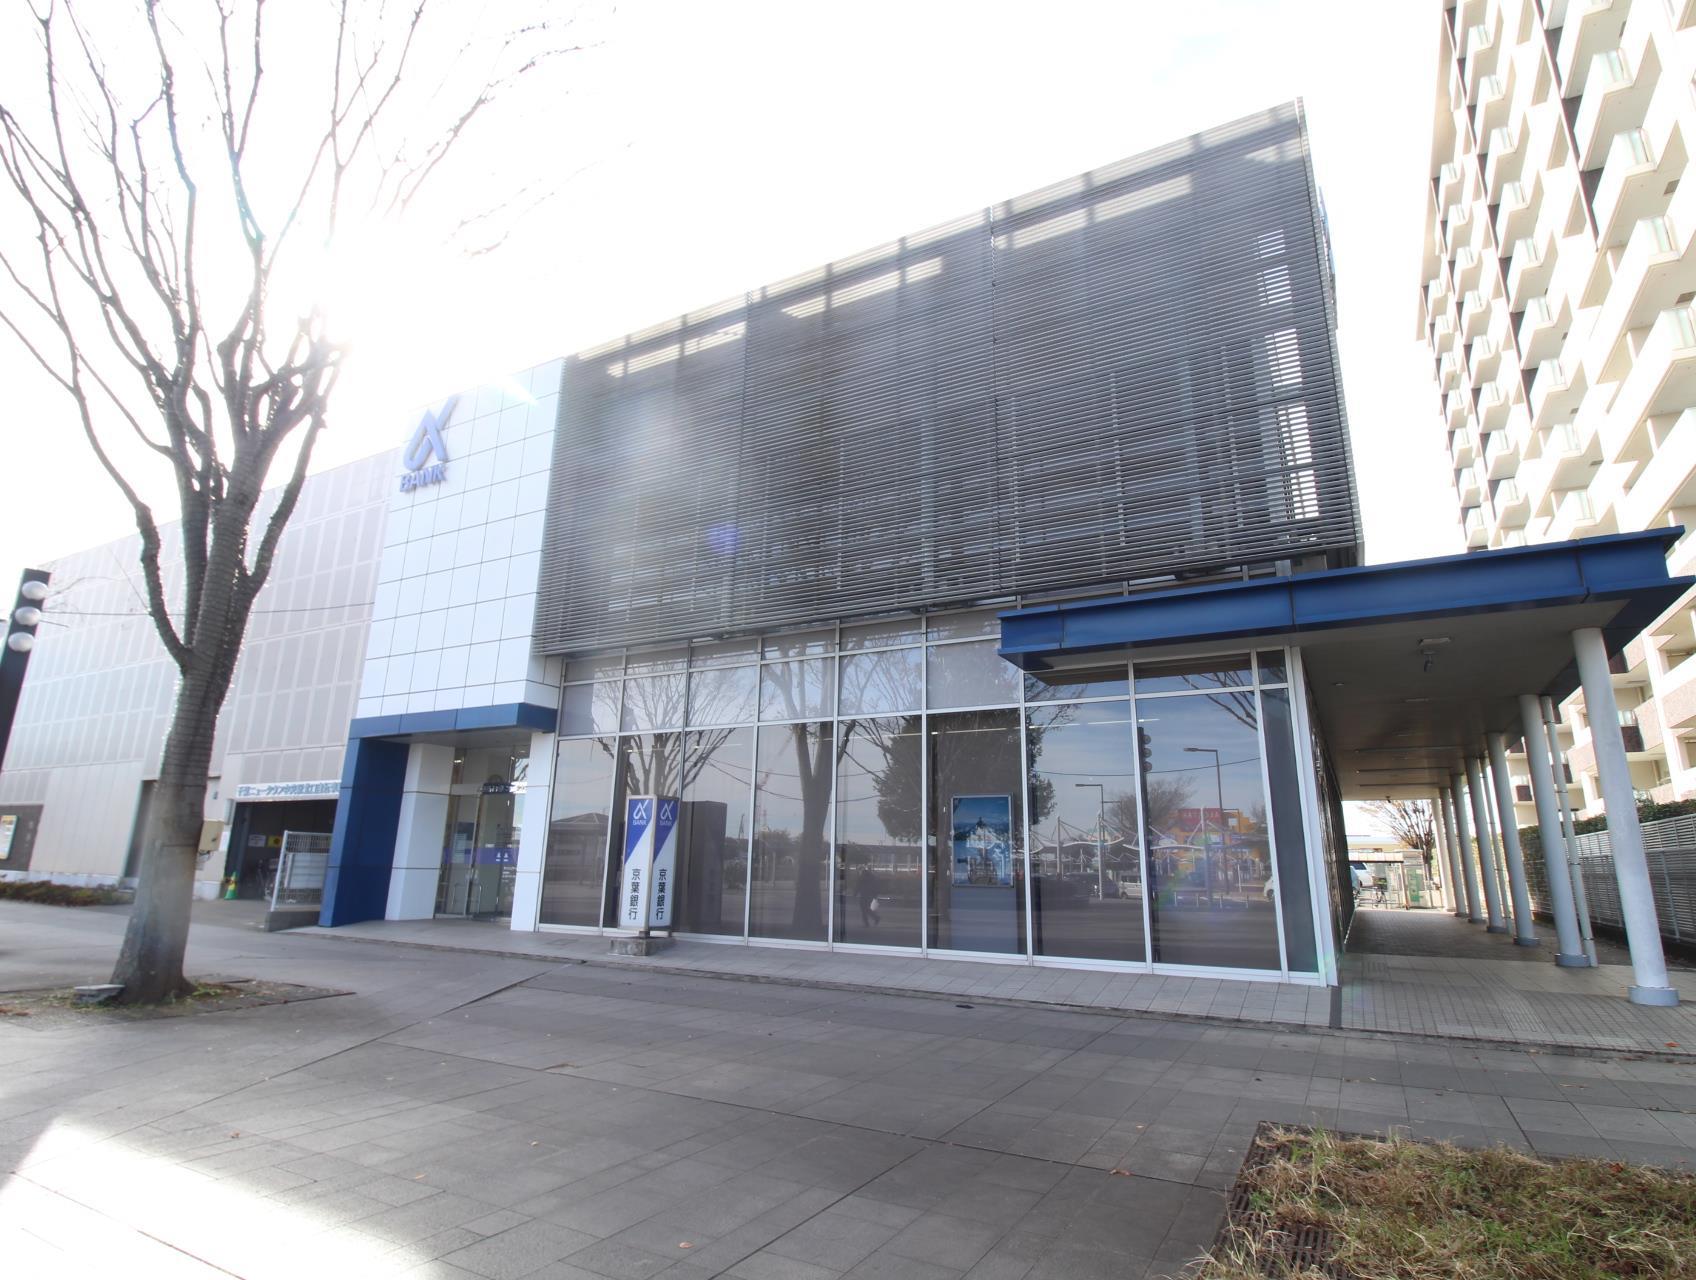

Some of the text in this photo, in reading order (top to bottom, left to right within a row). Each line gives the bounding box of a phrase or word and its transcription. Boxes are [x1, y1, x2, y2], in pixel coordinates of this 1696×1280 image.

[400, 462, 448, 493] BANK
[628, 868, 642, 920] 京葉銀行
[655, 868, 668, 920] 京葉銀行
